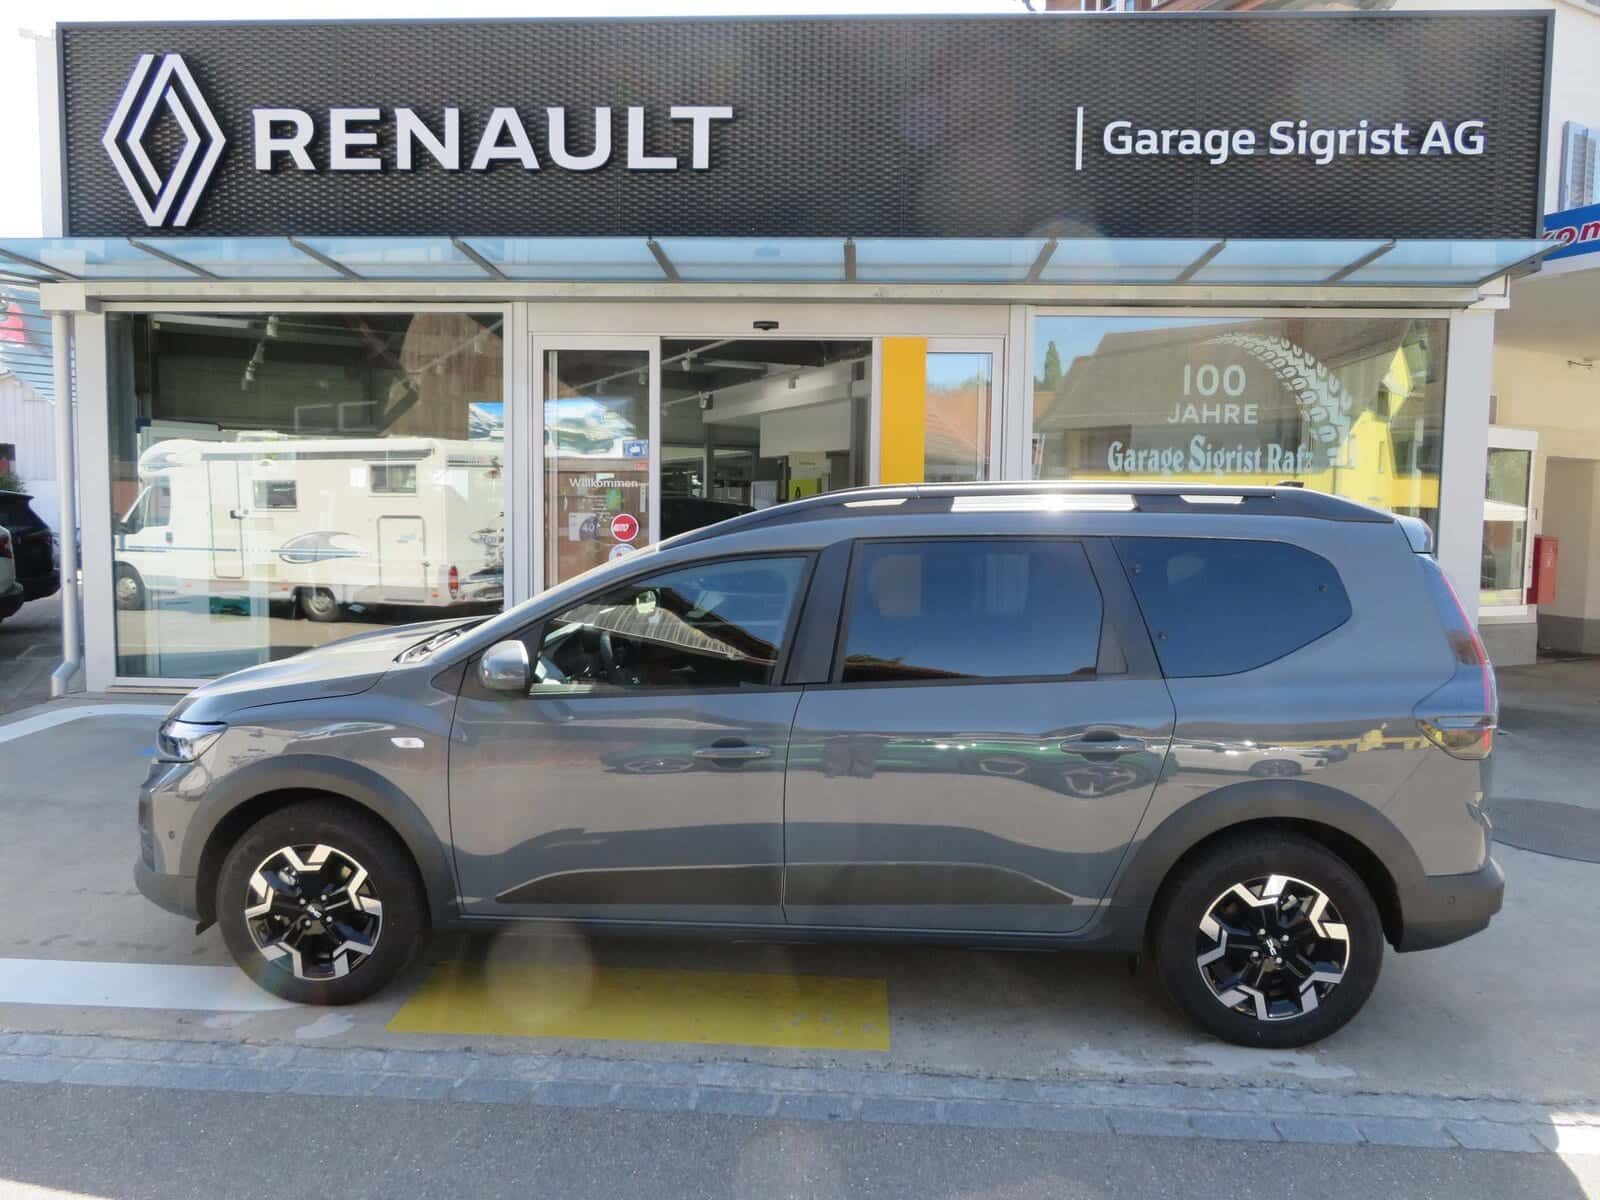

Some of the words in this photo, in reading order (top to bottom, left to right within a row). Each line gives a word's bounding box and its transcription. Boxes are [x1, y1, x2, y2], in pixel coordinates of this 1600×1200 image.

[253, 106, 733, 170] RENAULT
[1103, 120, 1256, 165] Garage
[1269, 119, 1409, 165] Sigrist
[1420, 120, 1486, 155] AG
[1183, 364, 1246, 396] 100
[1167, 402, 1259, 425] JAHRE
[1107, 441, 1184, 475] Garage
[1188, 434, 1262, 475] Sigrist
[1267, 443, 1313, 473] Rafz
[568, 477, 639, 488] Willkommen
